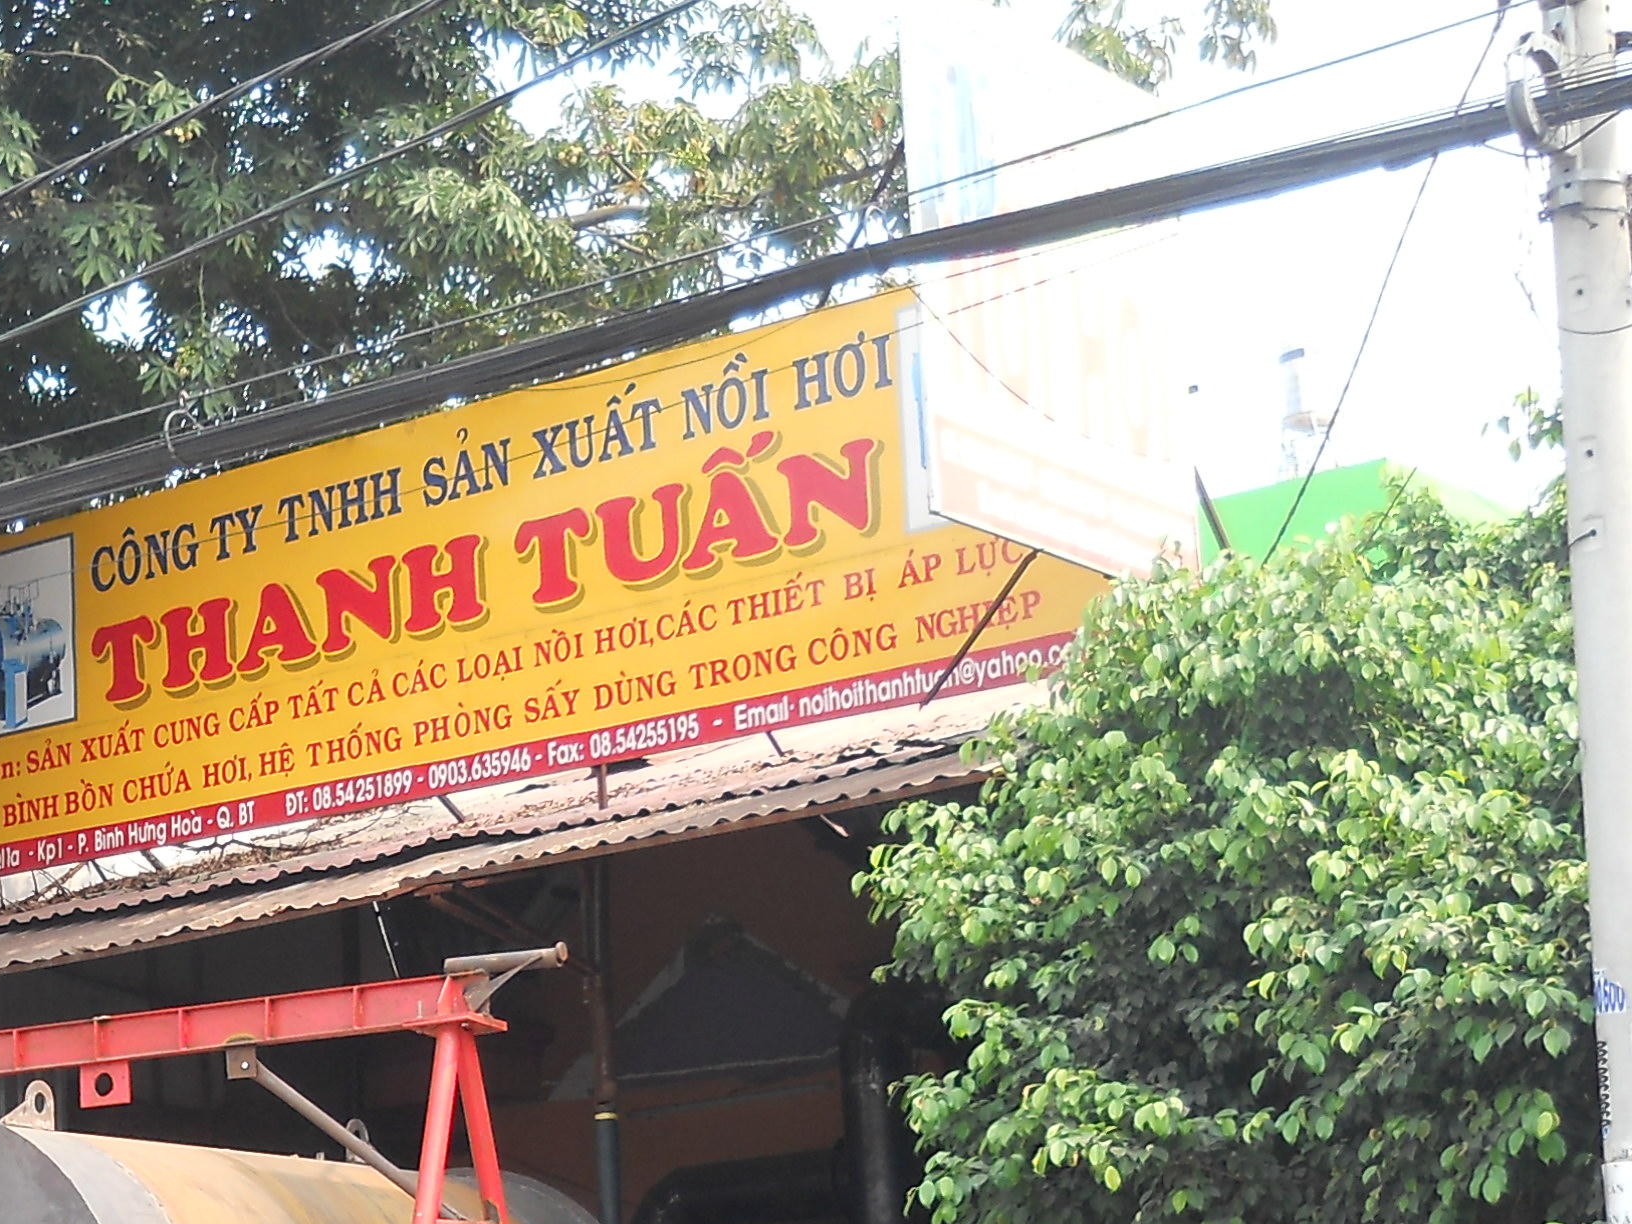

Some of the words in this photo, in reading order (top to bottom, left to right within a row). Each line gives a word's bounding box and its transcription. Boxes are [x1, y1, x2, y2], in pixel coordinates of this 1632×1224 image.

[90, 526, 200, 593] CÔNG
[209, 504, 264, 562] TY
[277, 466, 403, 544] TNHH
[422, 427, 511, 507] SẢN
[531, 382, 662, 480] XUẤT
[680, 351, 770, 441] NỒI
[791, 330, 895, 411] HƠI
[91, 533, 487, 706] THANH
[514, 430, 881, 608] TUẤN
[2, 793, 59, 828] BÌNH
[64, 778, 115, 816] BỒN
[122, 760, 193, 804] CHỨA
[258, 742, 295, 778] HỆ
[305, 721, 403, 768] THỐNG
[413, 700, 513, 747] PHÒNG
[523, 678, 581, 724] SẤY
[593, 670, 677, 712] DÙNG
[688, 643, 798, 691] TRONG
[807, 622, 899, 666] CÔNG
[26, 738, 73, 775] SẢN
[80, 720, 146, 764] XUẤT
[153, 711, 220, 749] CUNG
[228, 692, 280, 733] CẤP
[287, 679, 340, 720] TẤT
[347, 668, 386, 707] CẢ
[391, 659, 448, 698] CÁC
[456, 645, 524, 684] LOẠI
[534, 628, 585, 668] NỒI
[726, 571, 826, 626] THIẾT
[844, 567, 878, 602] BỊ
[897, 548, 943, 589] ÁP
[956, 535, 1024, 577] LỰC
[312, 770, 413, 810] 08.54251899
[427, 747, 532, 790] 0903.635946
[547, 740, 586, 767] Fax:
[589, 712, 700, 759] 08.54255195
[94, 826, 125, 852] Bình
[128, 820, 168, 846] Hưng
[238, 800, 256, 826] BT
